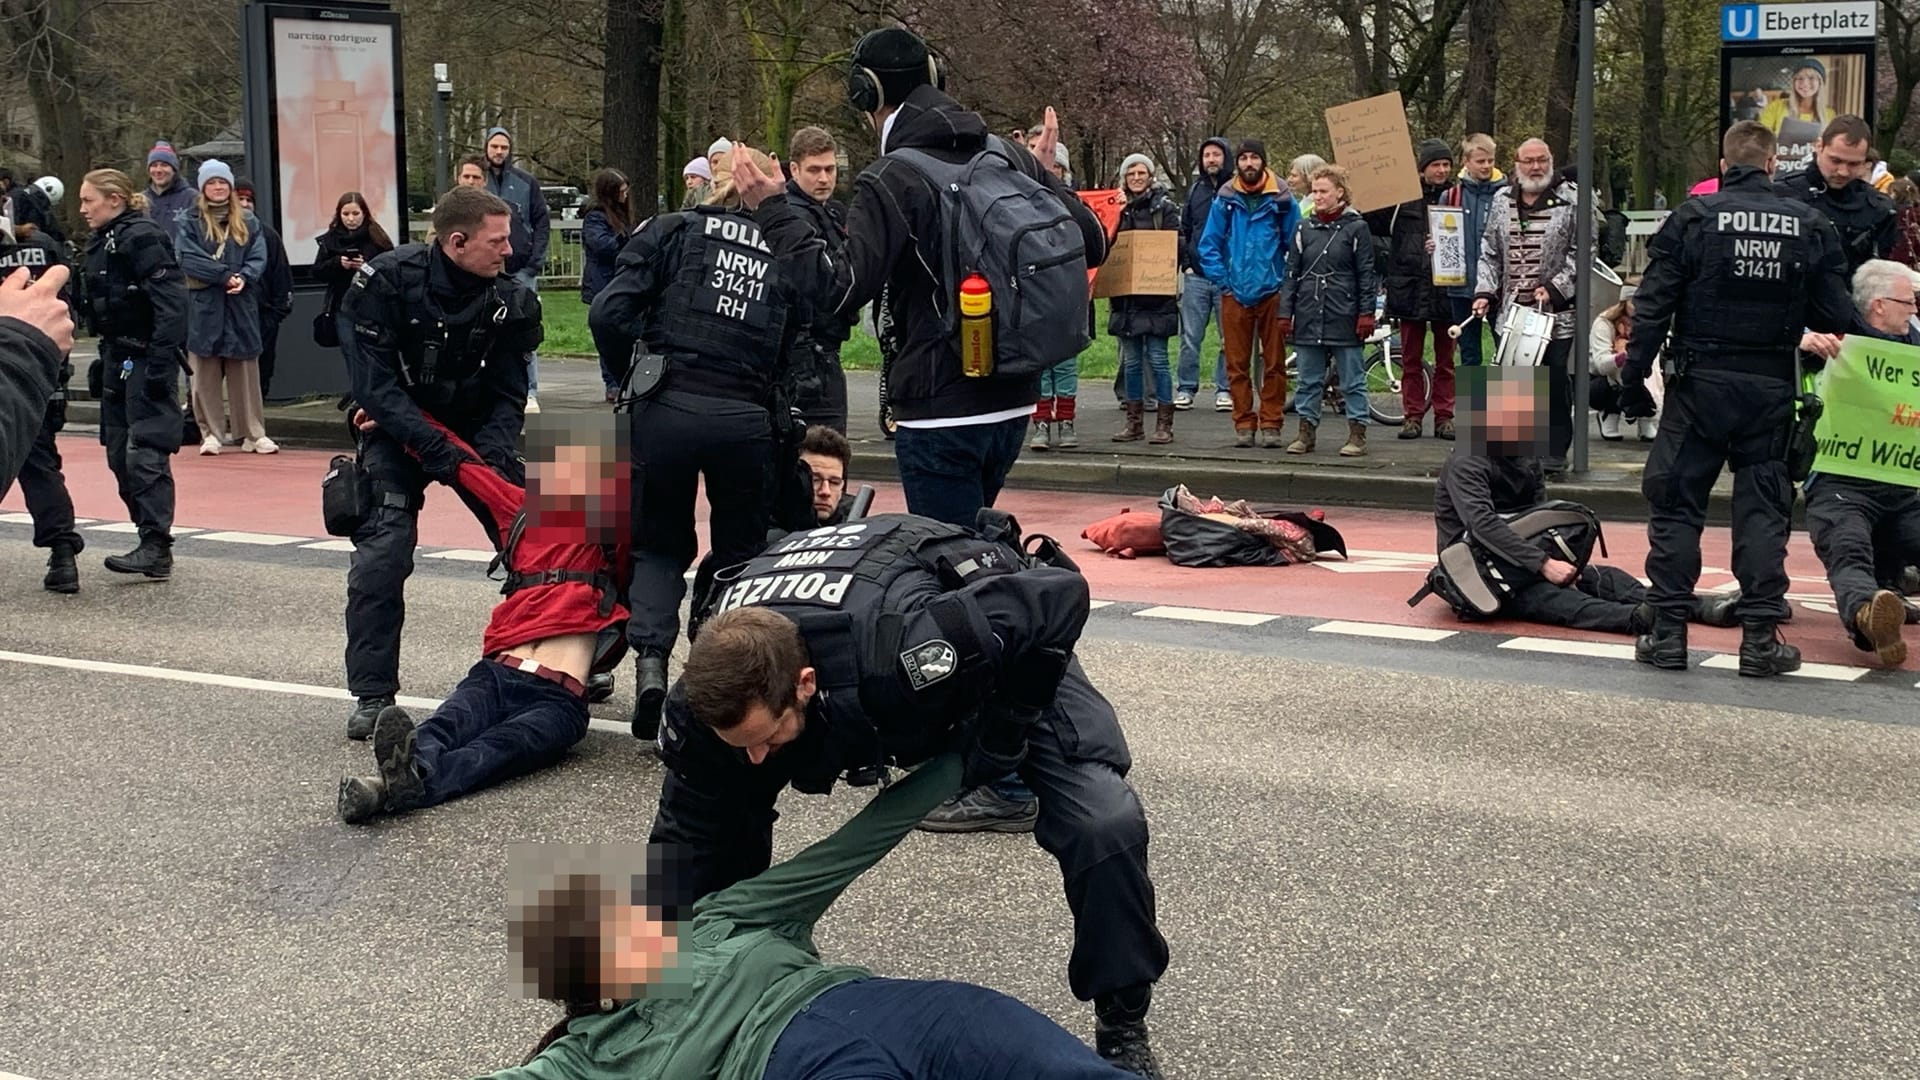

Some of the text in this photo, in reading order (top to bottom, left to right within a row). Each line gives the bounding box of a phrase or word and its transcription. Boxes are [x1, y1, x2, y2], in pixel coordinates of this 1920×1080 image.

[1728, 9, 1870, 37] U Ebertplatz
[287, 32, 378, 44] narciso rodriguez
[1775, 160, 1808, 173] syc
[1717, 211, 1800, 236] POLIZEI
[1734, 239, 1782, 258] NRW
[715, 248, 768, 279] NRW
[1733, 259, 1781, 279] 31411
[711, 270, 764, 301] 31411
[716, 295, 748, 320] RH
[1866, 355, 1904, 385] Wer
[1816, 433, 1863, 460] wird
[779, 535, 861, 553] 31411
[773, 551, 834, 568] NRW
[718, 572, 853, 616] POLIZEI
[906, 654, 926, 689] POLIZEI
